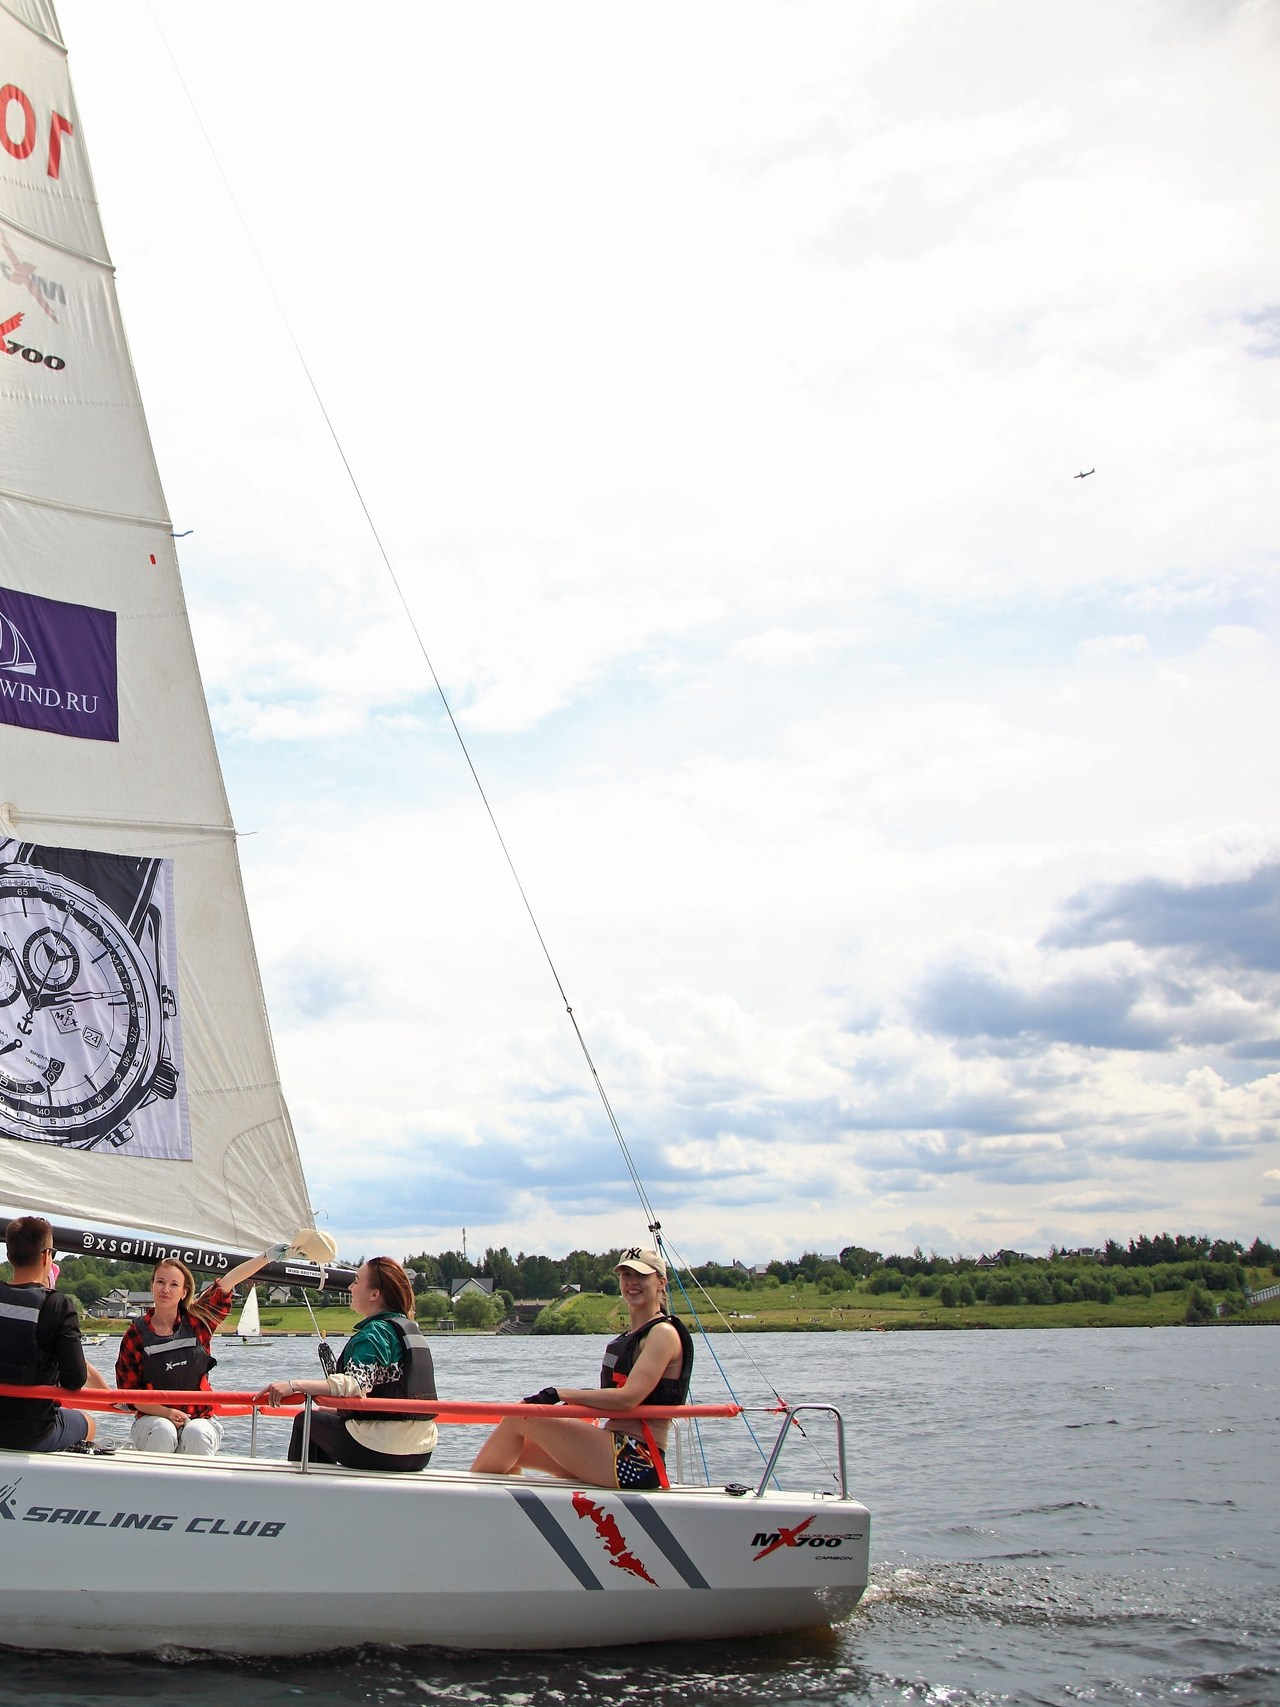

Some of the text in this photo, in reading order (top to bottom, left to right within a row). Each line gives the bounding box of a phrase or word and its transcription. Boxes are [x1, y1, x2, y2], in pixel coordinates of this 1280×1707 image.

[17, 888, 29, 896] 65
[66, 1007, 74, 1016] 6
[84, 1031, 99, 1045] 24
[129, 1026, 138, 1043] 275
[35, 1107, 51, 1116] 140
[82, 1232, 229, 1269] @xsailingclub
[625, 1246, 642, 1260] NY
[22, 1506, 179, 1531] SAILING
[184, 1517, 286, 1538] CLUB
[751, 1514, 842, 1562] MX700
